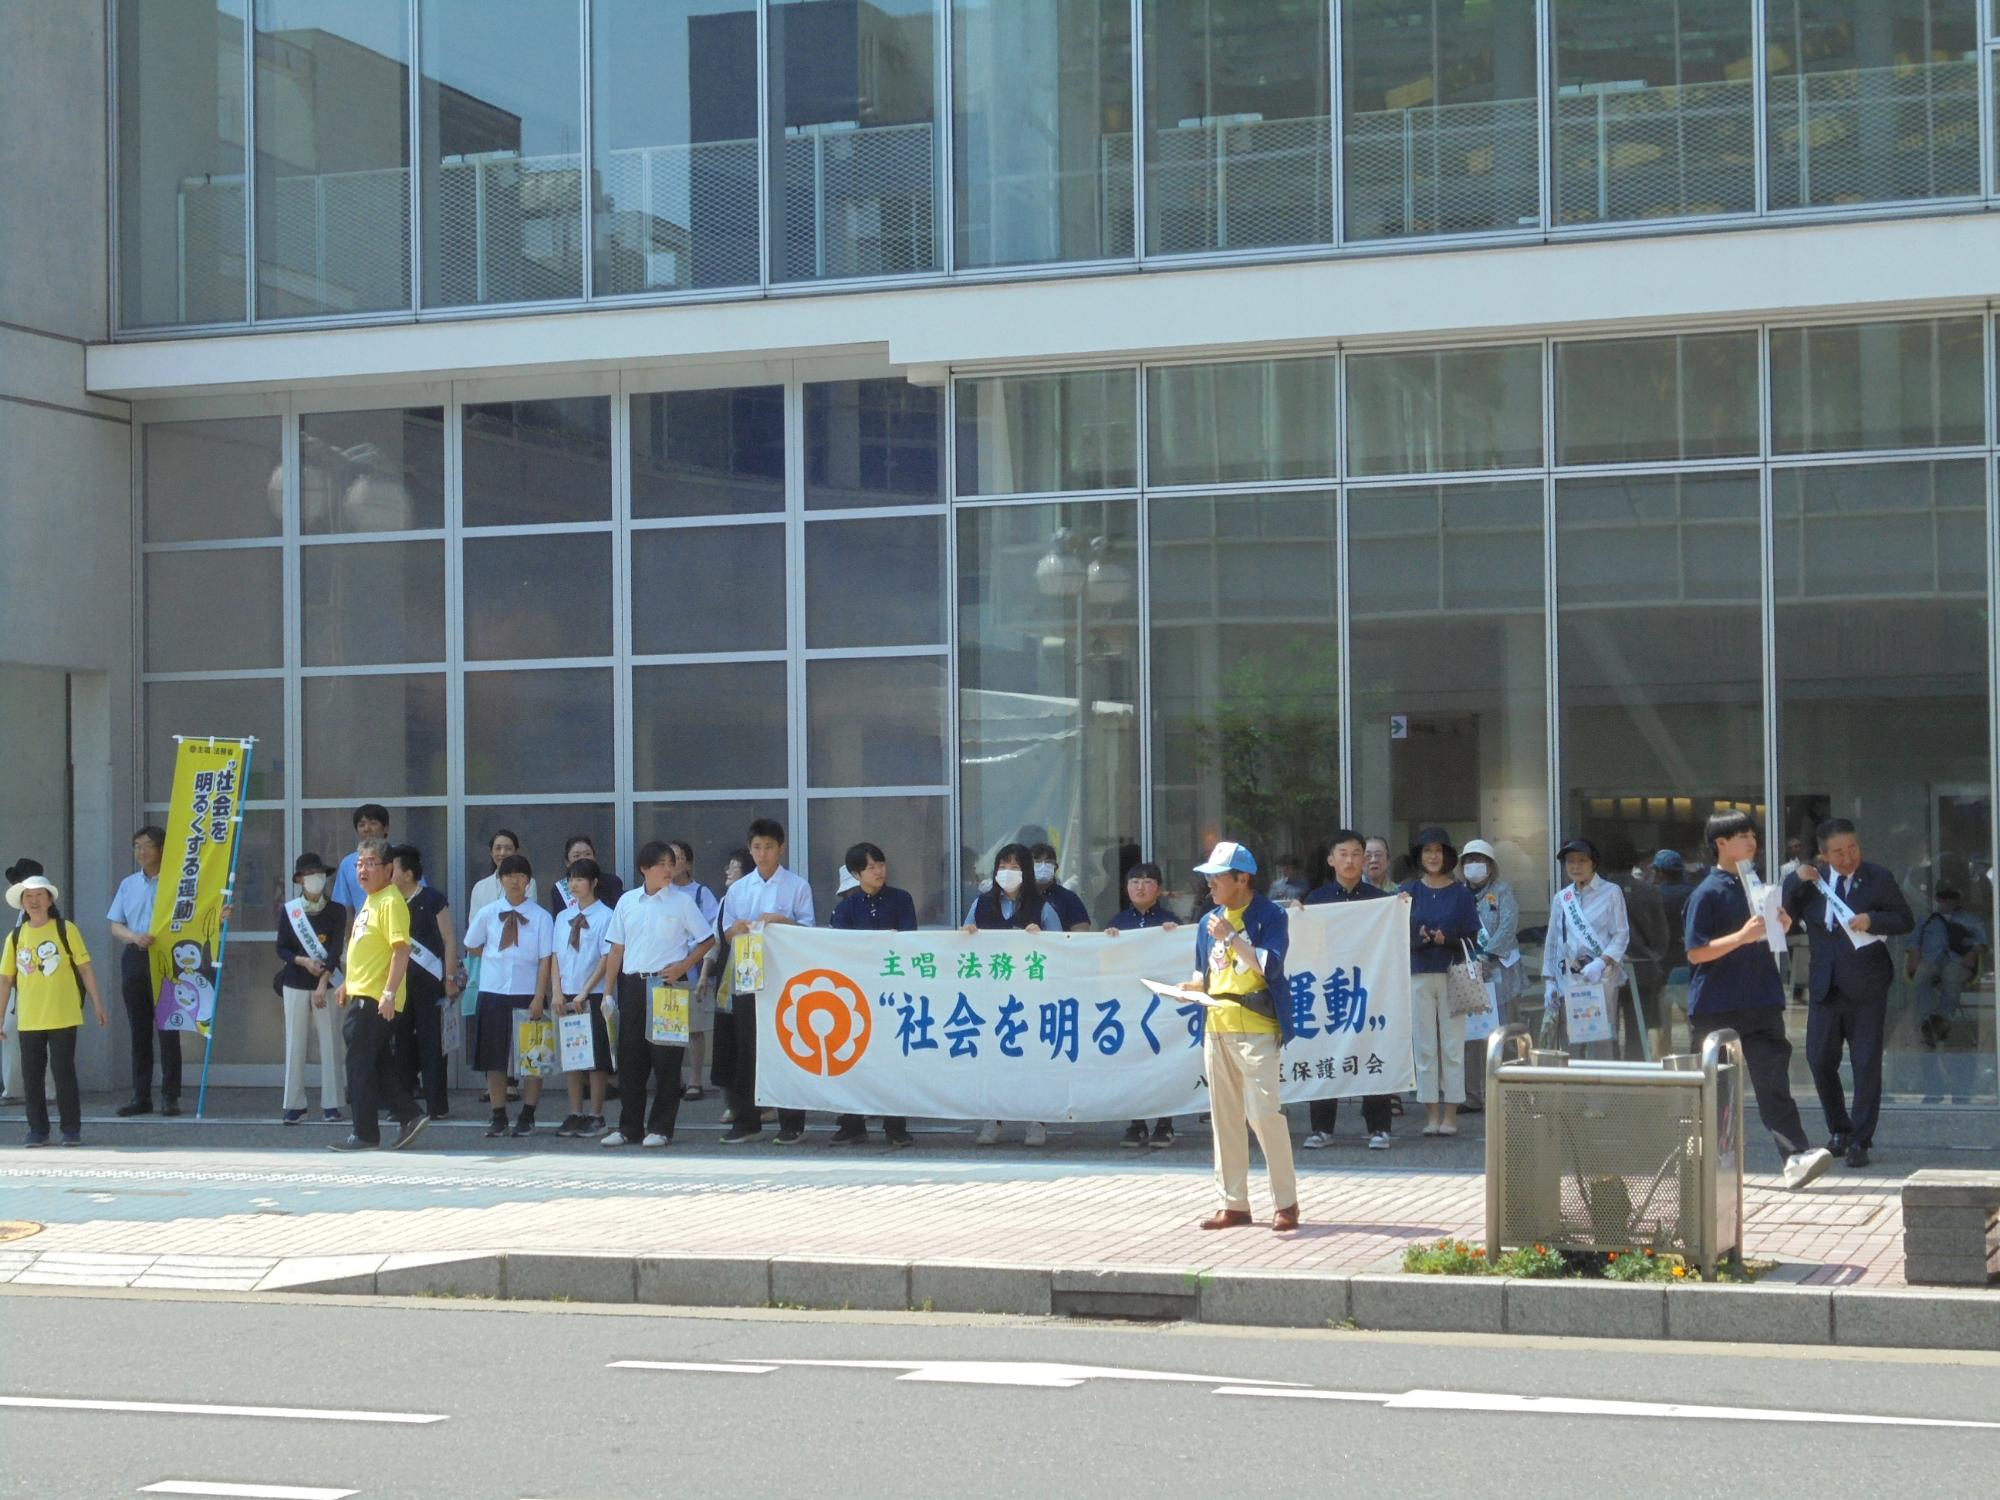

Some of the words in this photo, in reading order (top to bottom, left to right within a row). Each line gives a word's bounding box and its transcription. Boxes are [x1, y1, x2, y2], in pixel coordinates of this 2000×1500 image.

[880, 949, 937, 979] 主唱
[957, 950, 1047, 981] 法務省
